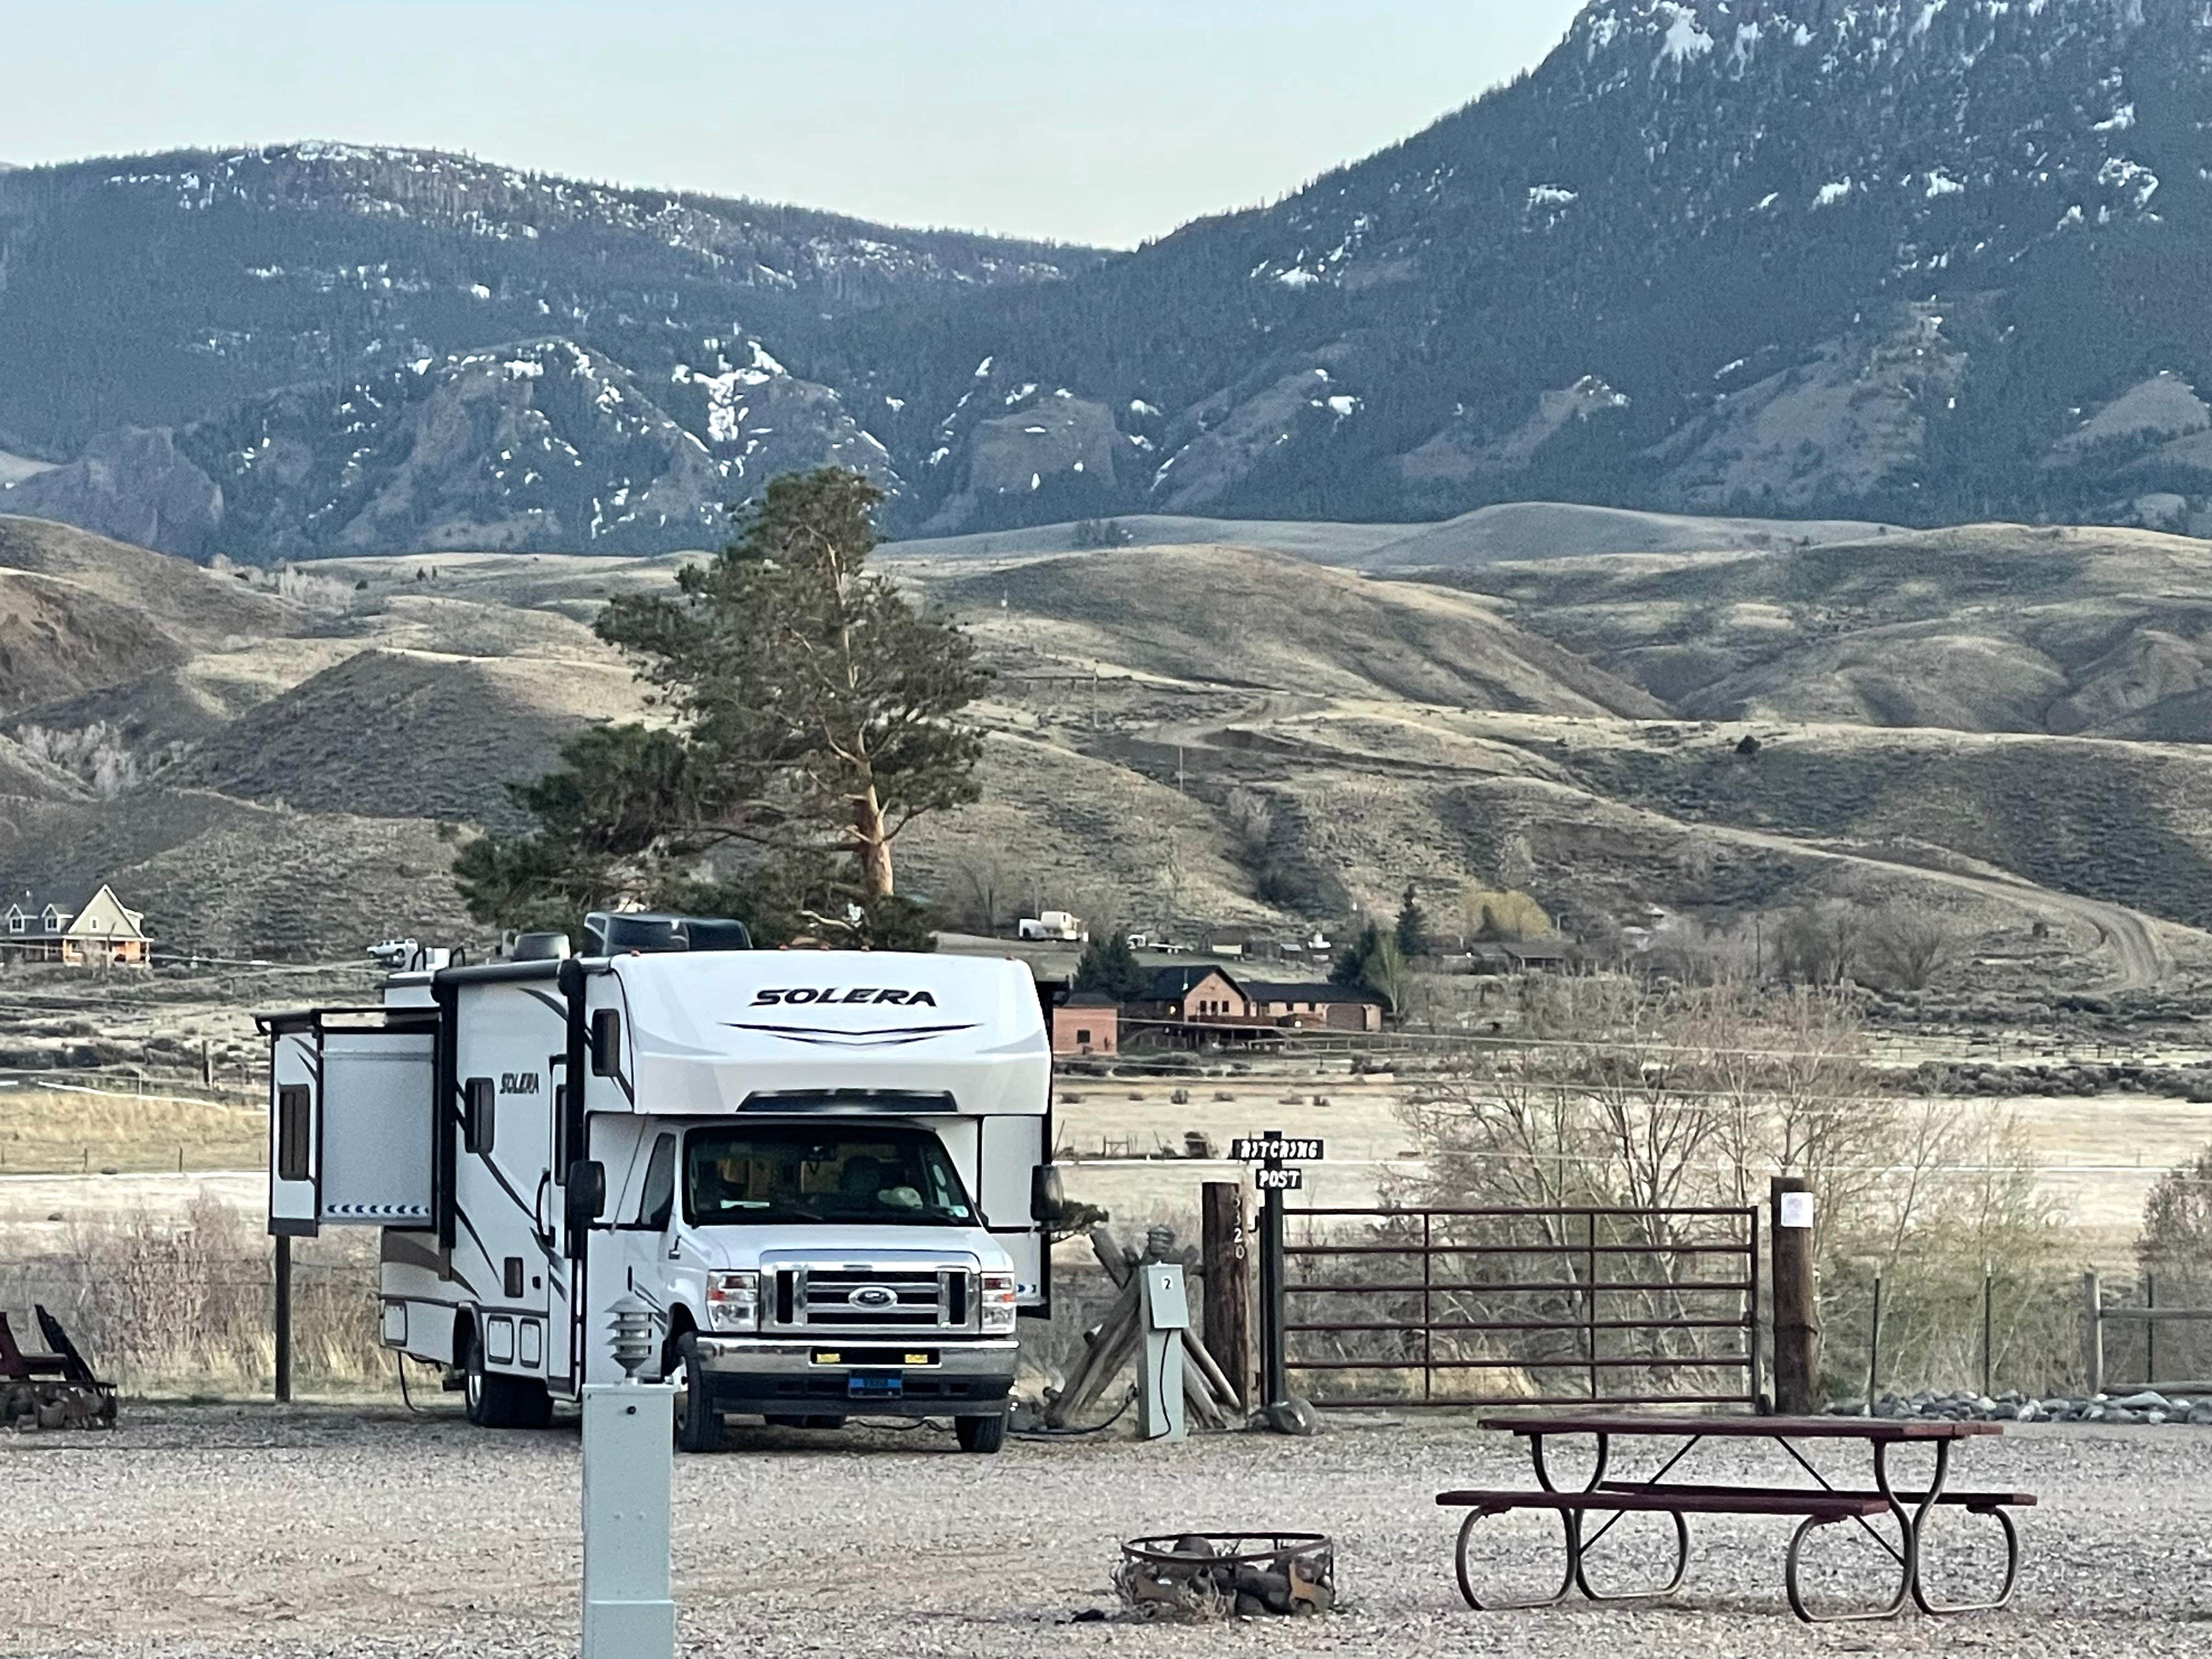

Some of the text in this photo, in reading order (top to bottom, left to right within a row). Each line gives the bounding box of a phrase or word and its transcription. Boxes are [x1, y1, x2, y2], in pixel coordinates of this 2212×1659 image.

[748, 988, 938, 1007] SOLERA
[1241, 1141, 1317, 1158] HITCHING
[1259, 1170, 1300, 1188] POST
[1164, 1278, 1172, 1290] 2
